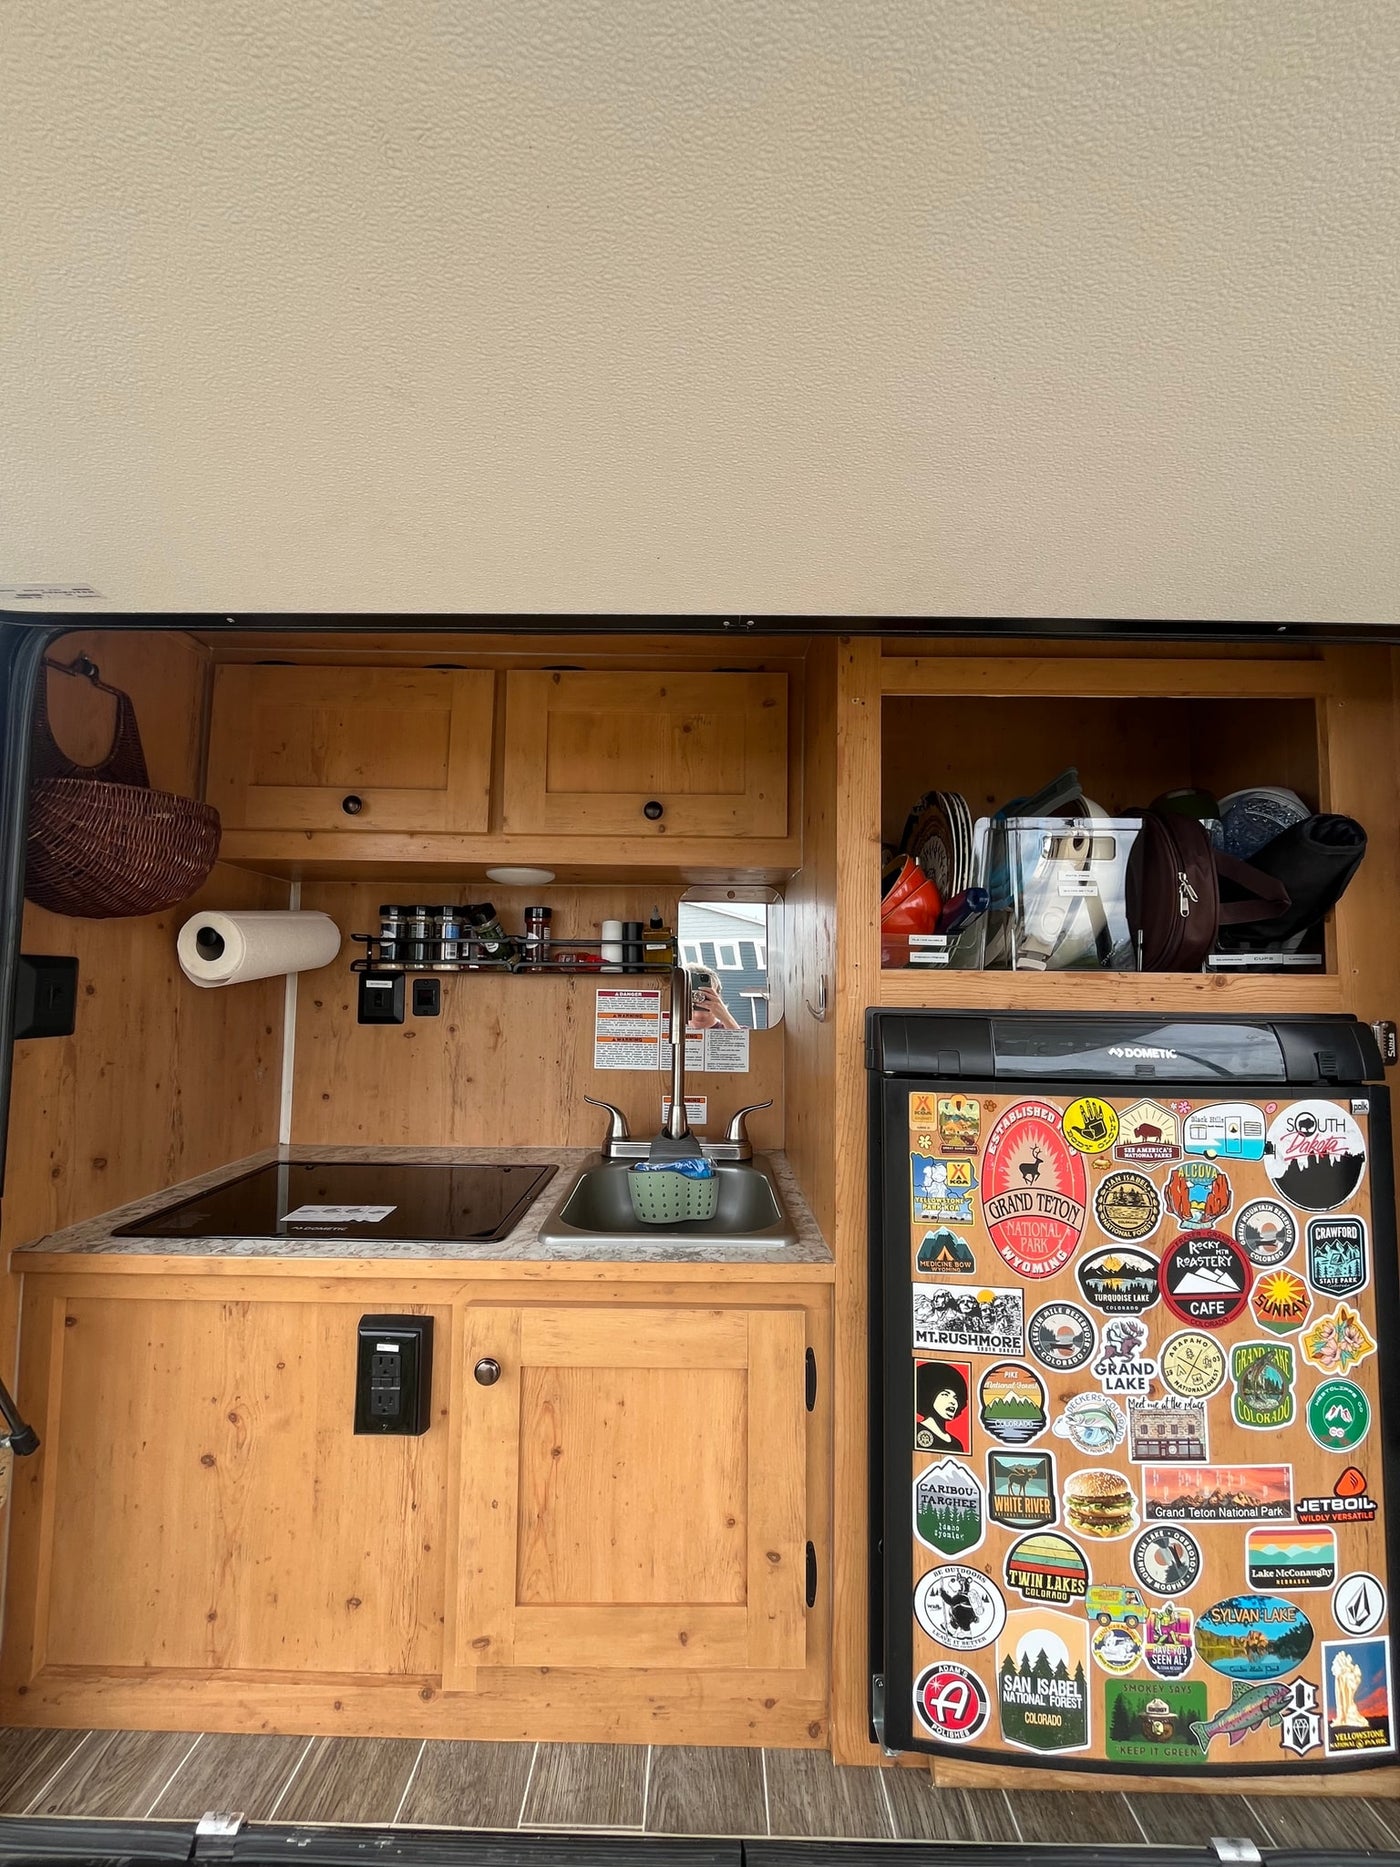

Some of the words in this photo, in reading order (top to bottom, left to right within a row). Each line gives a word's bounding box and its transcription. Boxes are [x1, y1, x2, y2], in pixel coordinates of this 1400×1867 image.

[1125, 1047, 1177, 1059] DOMETIC
[988, 1106, 1056, 1155] ESTABLISHED
[1286, 1112, 1346, 1137] SOUTH
[1280, 1131, 1349, 1155] Dakota
[1178, 1164, 1218, 1178] ALCOVA
[1106, 1176, 1121, 1188] SAN
[1122, 1174, 1149, 1190] ISABEL
[944, 1204, 960, 1212] KOA
[989, 1193, 1033, 1219] GRAND
[1036, 1193, 1080, 1225] TETON
[1006, 1221, 1062, 1238] NATIONAL
[1102, 1219, 1132, 1238] NATIONAL
[1132, 1222, 1154, 1237] FOREST
[1244, 1205, 1274, 1223] MOUNTAIN
[1274, 1206, 1293, 1243] RESERVOIR
[1315, 1226, 1358, 1240] CRAWFORD
[1021, 1237, 1049, 1254] PARK
[1001, 1245, 1068, 1274] WYOMING
[1250, 1250, 1285, 1263] COLORADO
[1094, 1294, 1135, 1302] TURQUOISE
[1136, 1294, 1150, 1302] LAKE
[1190, 1301, 1226, 1315] CAFE
[1254, 1294, 1308, 1318] SUNRAY
[1044, 1306, 1063, 1317] MILE
[1065, 1307, 1091, 1348] RESERVOIR
[1190, 1316, 1229, 1328] COLORADO
[916, 1330, 1022, 1349] MT.RUSHMORE
[1169, 1338, 1208, 1358] ARAPAHO
[1040, 1352, 1084, 1366] COLORADO
[1236, 1347, 1266, 1378] GRAND
[1094, 1363, 1154, 1376] GRAND
[1106, 1377, 1146, 1390] LAKE
[1174, 1380, 1204, 1392] NATIONAL
[1204, 1370, 1220, 1390] FOREST
[1128, 1396, 1146, 1410] Meet
[1161, 1396, 1169, 1410] at
[1170, 1396, 1182, 1409] the
[1184, 1398, 1205, 1410] place
[1238, 1396, 1290, 1424] COLORADO
[1066, 1394, 1102, 1412] DECKERS
[1105, 1398, 1125, 1442] COLORADO
[920, 1484, 978, 1496] CARIBOU-
[921, 1495, 977, 1508] TARGHEE
[994, 1496, 1023, 1513] WHITE
[1024, 1497, 1051, 1514] RIVER
[1297, 1497, 1374, 1512] JETBOIL
[1155, 1506, 1185, 1518] Grand
[1188, 1506, 1216, 1518] Teton
[1219, 1506, 1258, 1517] National
[1261, 1506, 1283, 1516] Park
[1300, 1514, 1330, 1522] WILDLY
[1332, 1512, 1374, 1520] VERSATILE
[1146, 1530, 1165, 1543] LAKE
[1173, 1532, 1196, 1573] COLORADO
[1137, 1543, 1154, 1584] MOUNTAIN
[933, 1570, 944, 1578] BE
[944, 1568, 987, 1584] OUTDOORS
[1252, 1569, 1274, 1578] Lake
[1276, 1568, 1333, 1579] McConaughy
[1009, 1570, 1044, 1589] TWIN
[1047, 1574, 1086, 1594] LAKES
[1154, 1580, 1186, 1591] SHADOW
[1025, 1587, 1068, 1600] COLORADO
[1211, 1608, 1260, 1622] SYLVAN
[1264, 1608, 1297, 1623] LAKE
[932, 1630, 952, 1644] LEAVE
[962, 1636, 987, 1646] BETTER
[1174, 1646, 1187, 1656] YOU
[1152, 1654, 1172, 1665] SEEN
[1174, 1654, 1188, 1666] AL?
[1004, 1675, 1033, 1692] SAN
[1036, 1679, 1082, 1698] ISABEL
[1123, 1684, 1165, 1694] SMOKEY
[1168, 1686, 1192, 1694] SAYS
[1003, 1693, 1046, 1706] NATIONAL
[1050, 1696, 1083, 1710] FOREST
[1024, 1712, 1062, 1727] COLORADO
[1334, 1729, 1384, 1741] YELLOWSTONE
[1120, 1746, 1146, 1756] KEEP
[1164, 1748, 1198, 1757] GREEN
